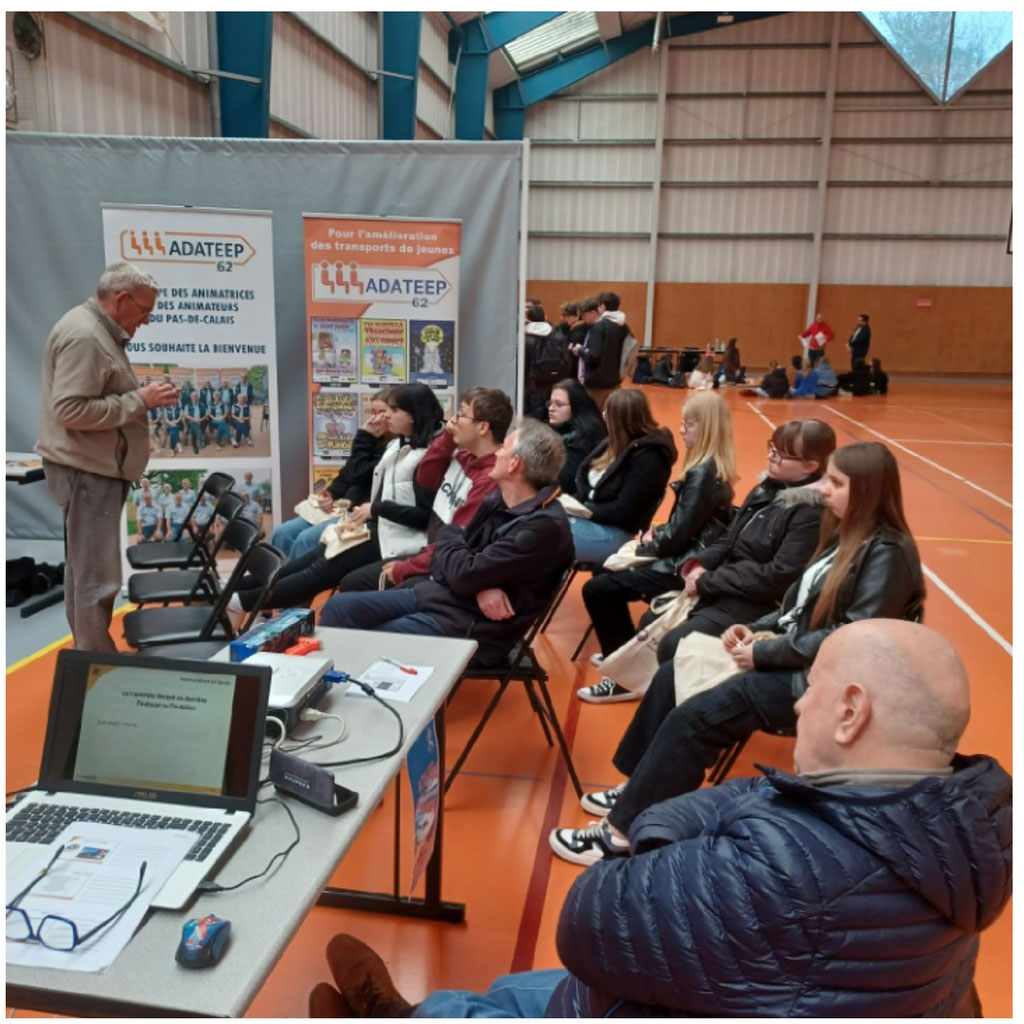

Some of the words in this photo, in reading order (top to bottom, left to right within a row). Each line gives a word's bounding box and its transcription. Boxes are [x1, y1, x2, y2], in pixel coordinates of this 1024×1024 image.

[328, 229, 354, 238] Pour
[358, 229, 438, 241] l'amélioration
[169, 241, 244, 258] ADATEEP
[310, 241, 331, 249] des
[334, 242, 396, 254] transports
[399, 244, 414, 253] de
[417, 245, 455, 255] jeunes
[217, 262, 233, 272] 62
[366, 278, 447, 295] ADATEEP
[171, 288, 188, 298] DES
[191, 289, 255, 300] ANIMATRICES
[157, 301, 174, 310] DES
[178, 302, 239, 312] ANIMATEURS
[412, 298, 428, 308] 62
[149, 314, 163, 323] DU
[166, 315, 235, 324] PAS-DE-CALAIS
[127, 343, 146, 352] OUS
[148, 343, 196, 352] SOUHAITE
[198, 344, 210, 353] LA
[213, 344, 267, 354] BIENVENUE
